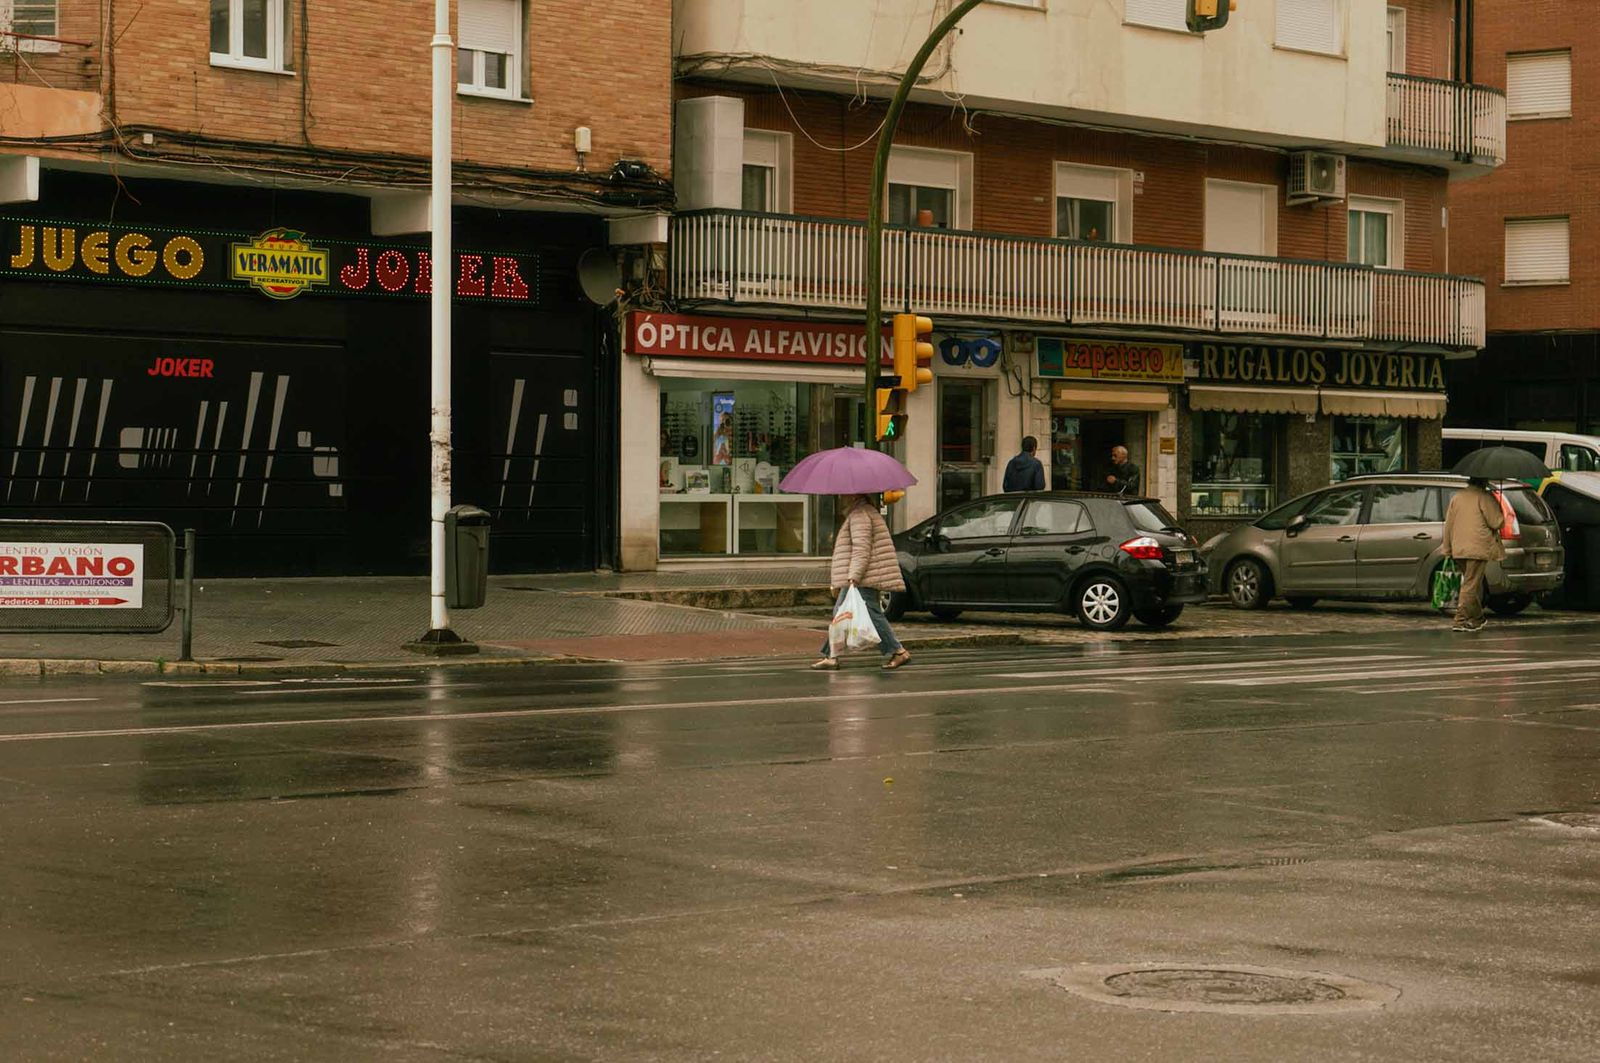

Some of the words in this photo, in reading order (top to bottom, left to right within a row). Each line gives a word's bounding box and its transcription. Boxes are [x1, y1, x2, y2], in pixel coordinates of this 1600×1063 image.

[11, 225, 205, 280] JUEGO
[238, 252, 323, 276] VERAMATIC
[257, 277, 305, 285] RECREATIVOS
[637, 315, 736, 353] ÓPTICA
[148, 357, 215, 378] JOKER
[1065, 341, 1164, 378] zapatero
[1202, 344, 1328, 384] REGALOS
[1335, 351, 1446, 389] JOYERIA
[59, 545, 103, 556] VISIÓN
[13, 578, 60, 586] LENTILLAS
[68, 577, 126, 586] AUDÍFONOS
[0, 598, 40, 606] Federico
[44, 598, 76, 606] Molina
[88, 598, 100, 606] 39
